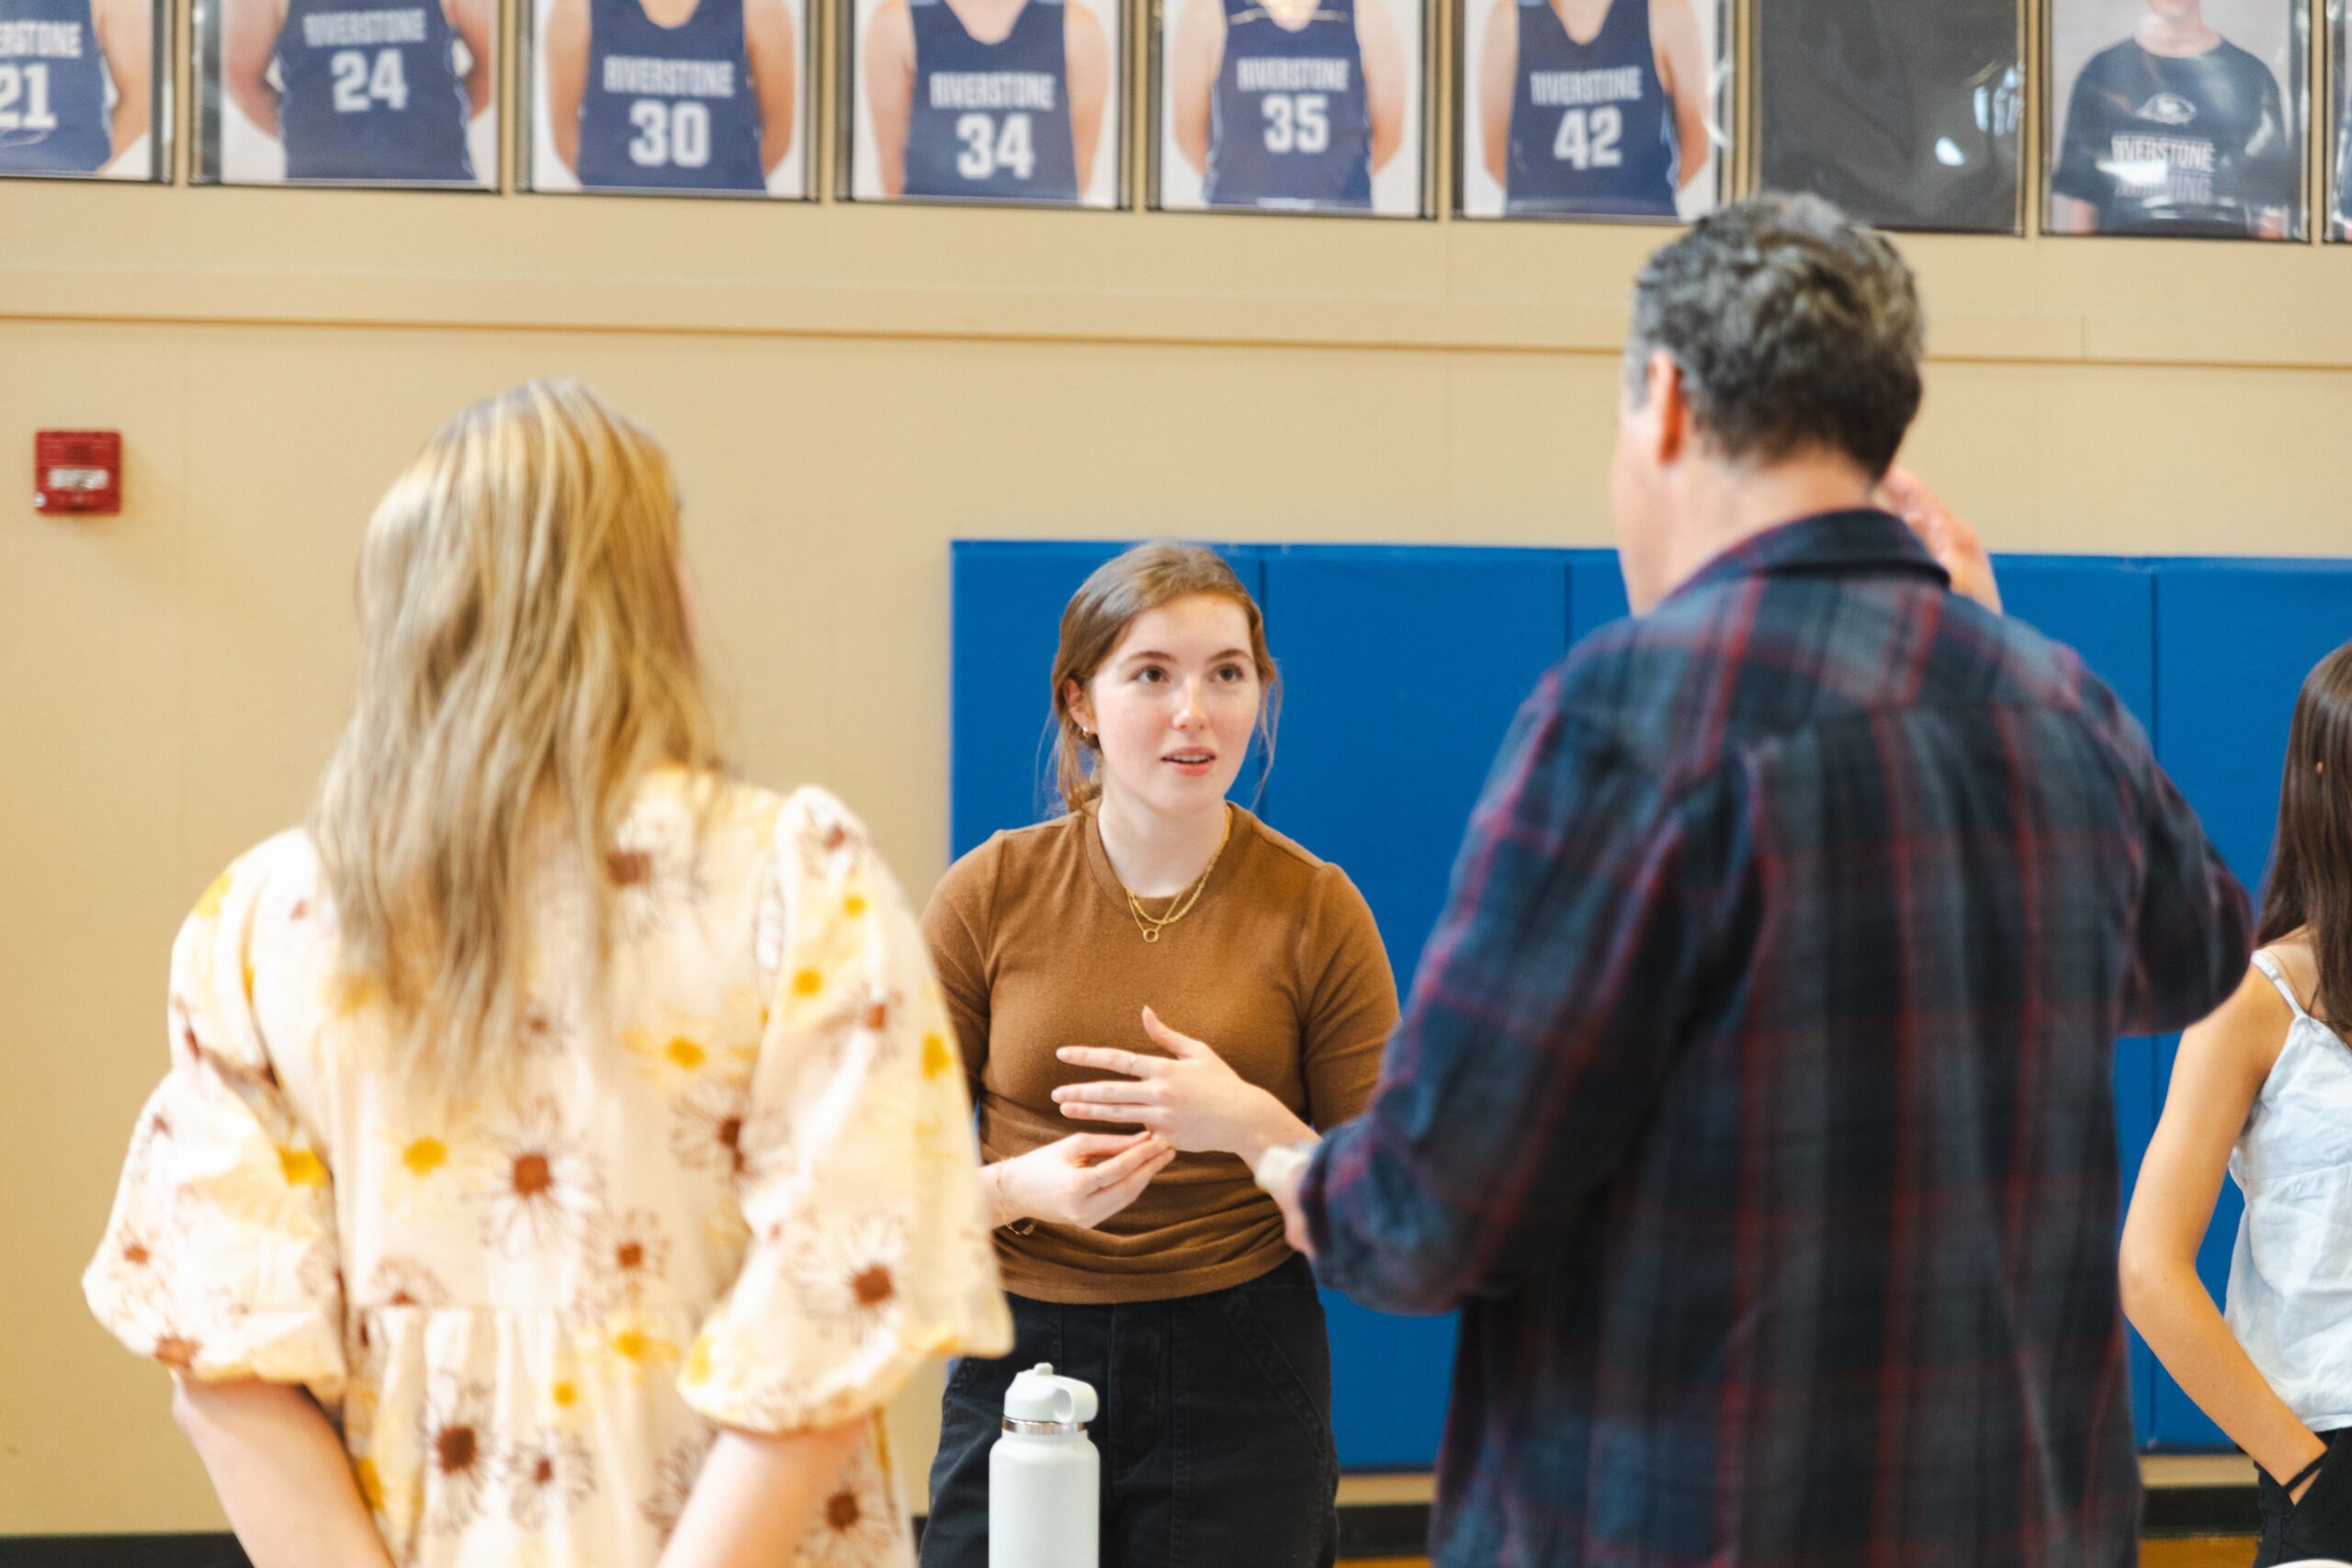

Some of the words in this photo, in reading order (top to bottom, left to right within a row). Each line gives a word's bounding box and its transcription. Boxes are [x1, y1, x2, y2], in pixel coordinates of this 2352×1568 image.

[302, 8, 427, 48] RIVERSTONE
[0, 62, 57, 129] 21
[331, 49, 409, 112] 24
[603, 55, 734, 98] RIVERSTONE
[929, 72, 1055, 110] RIVERSTONE
[1237, 57, 1350, 92] RIVERSTONE
[1530, 65, 1643, 107] RIVERSTONE
[629, 98, 711, 168] 30
[956, 112, 1035, 180] 34
[1261, 93, 1330, 154] 35
[1554, 106, 1623, 171] 42
